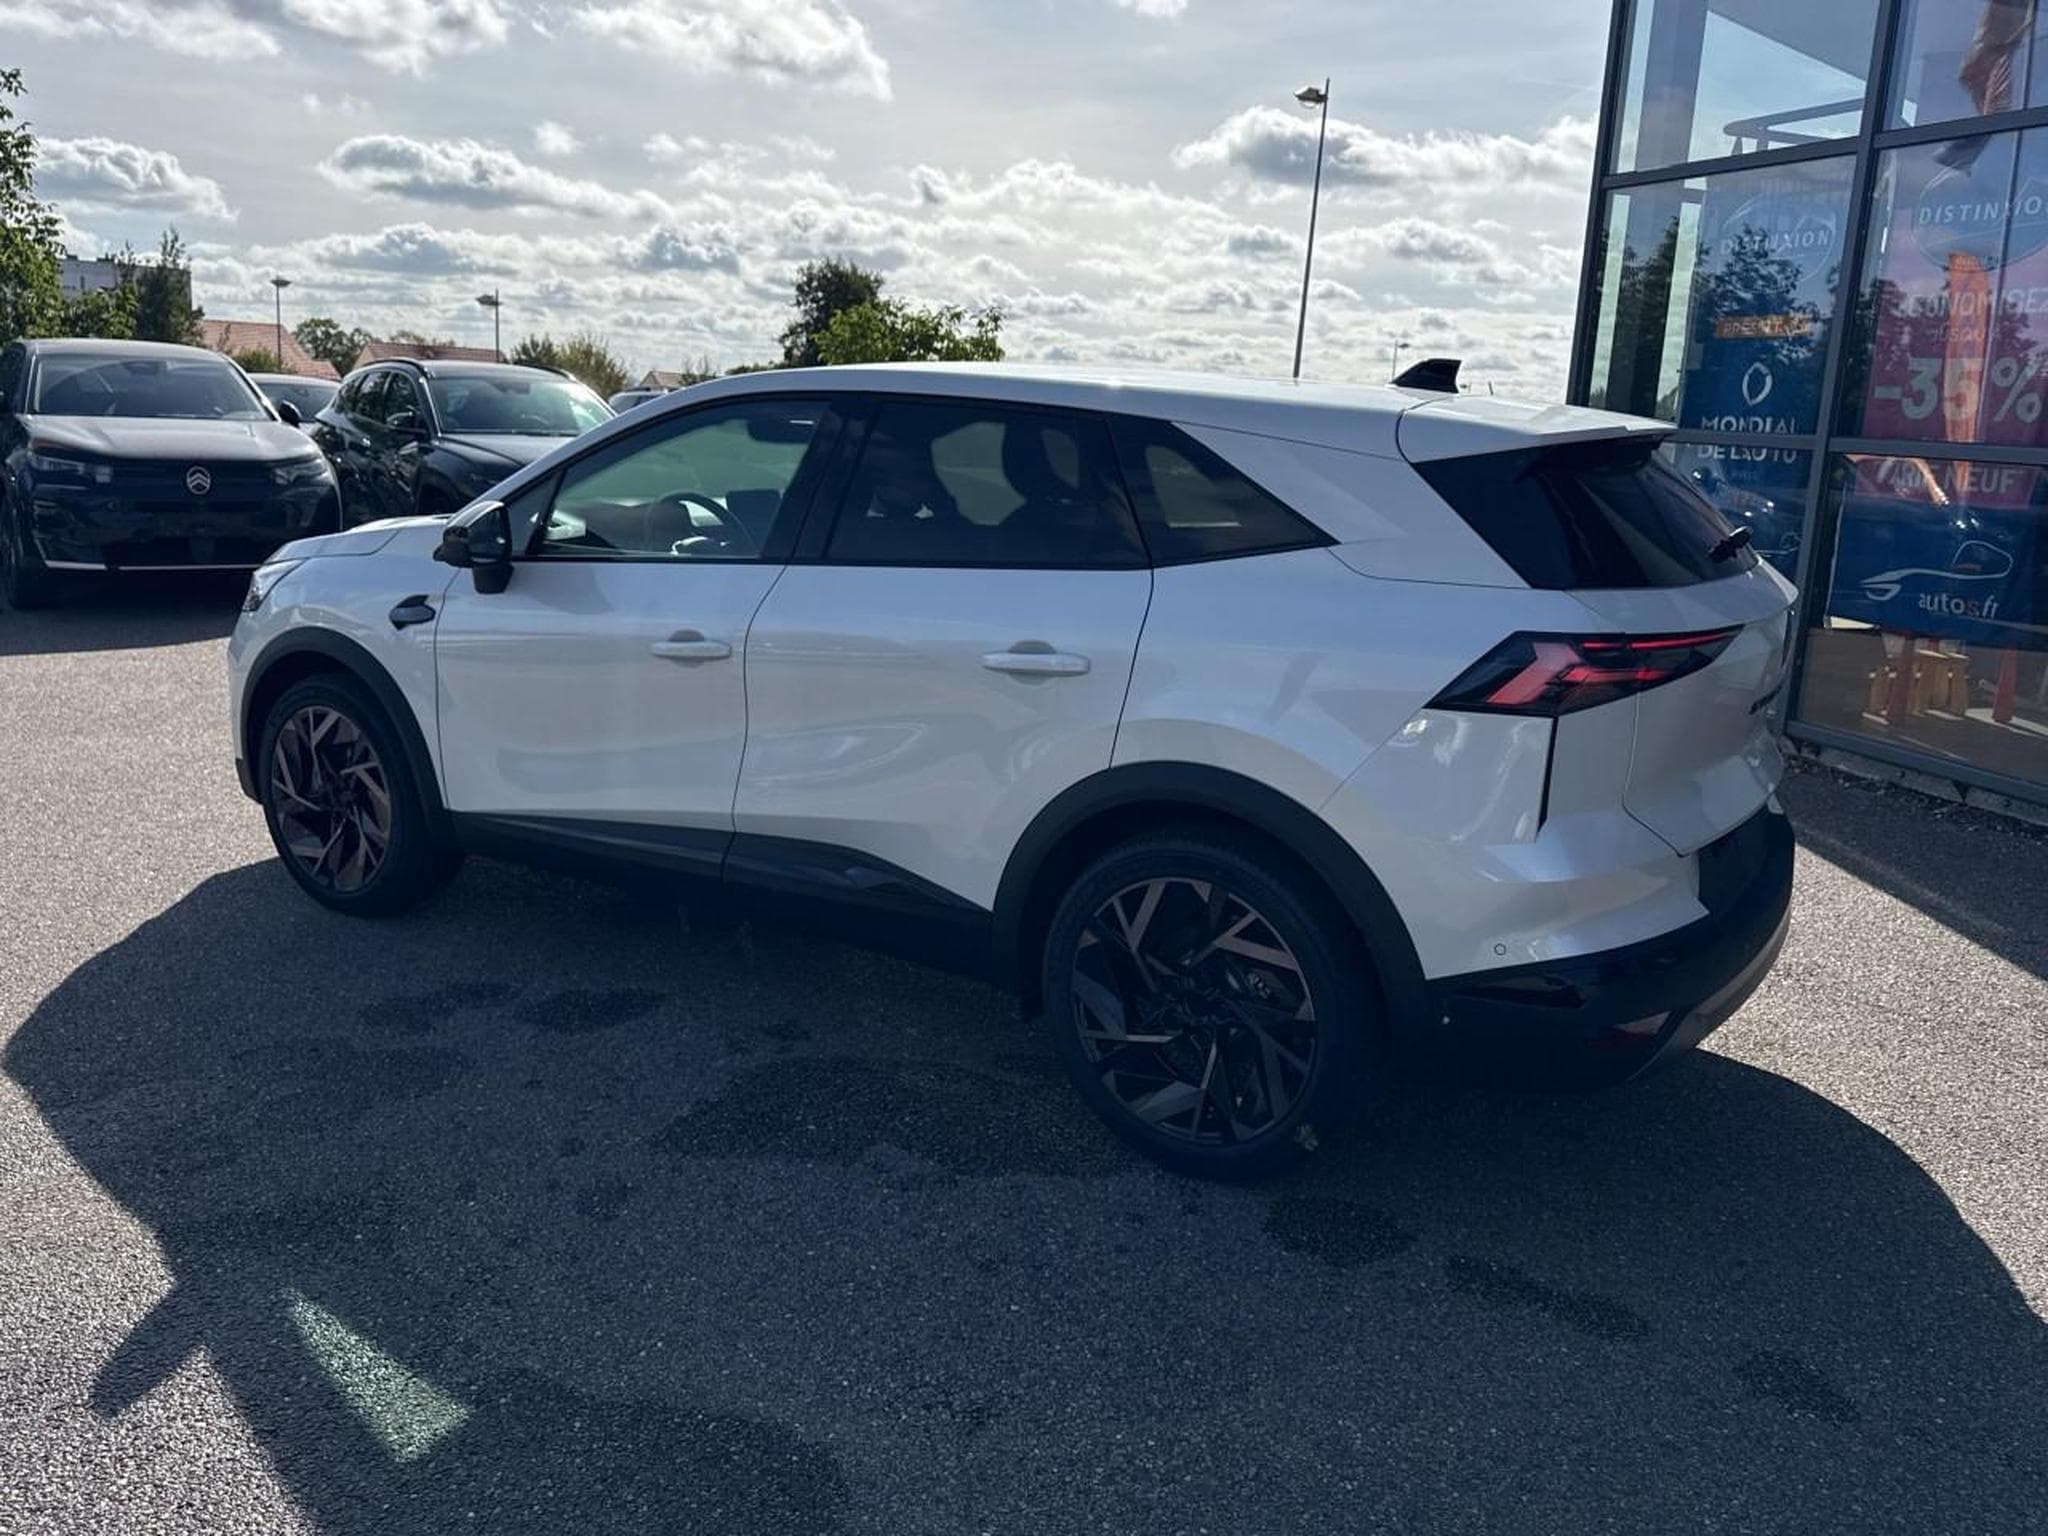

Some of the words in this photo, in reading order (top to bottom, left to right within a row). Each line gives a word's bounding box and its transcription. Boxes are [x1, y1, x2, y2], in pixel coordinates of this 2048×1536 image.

[1920, 195, 2048, 225] DISTINIO
[1730, 445, 1797, 464] LAUTO
[1945, 463, 2015, 494] NEUF
